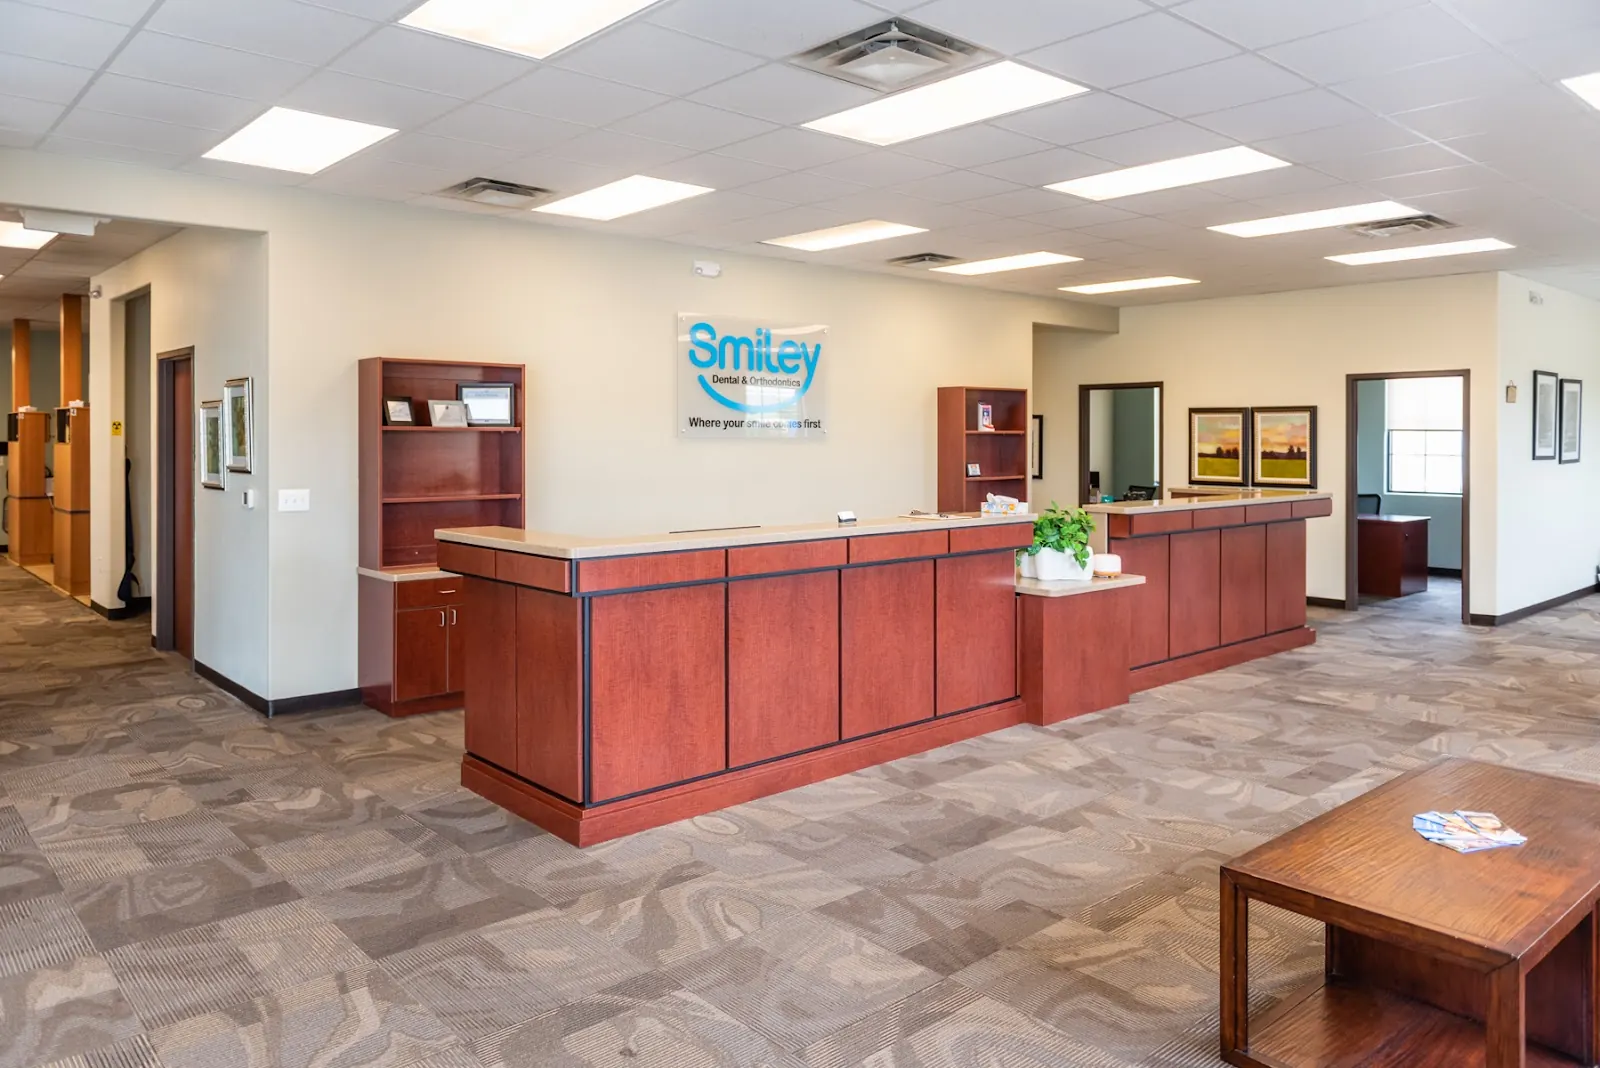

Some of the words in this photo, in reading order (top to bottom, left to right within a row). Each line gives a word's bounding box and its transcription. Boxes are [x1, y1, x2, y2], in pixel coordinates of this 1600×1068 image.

[688, 322, 822, 392] Smiley
[712, 374, 740, 385] Dental
[741, 375, 748, 385] &
[749, 377, 801, 388] Orthodontics
[688, 416, 721, 428] Where
[723, 418, 745, 430] your
[803, 417, 821, 429] first
